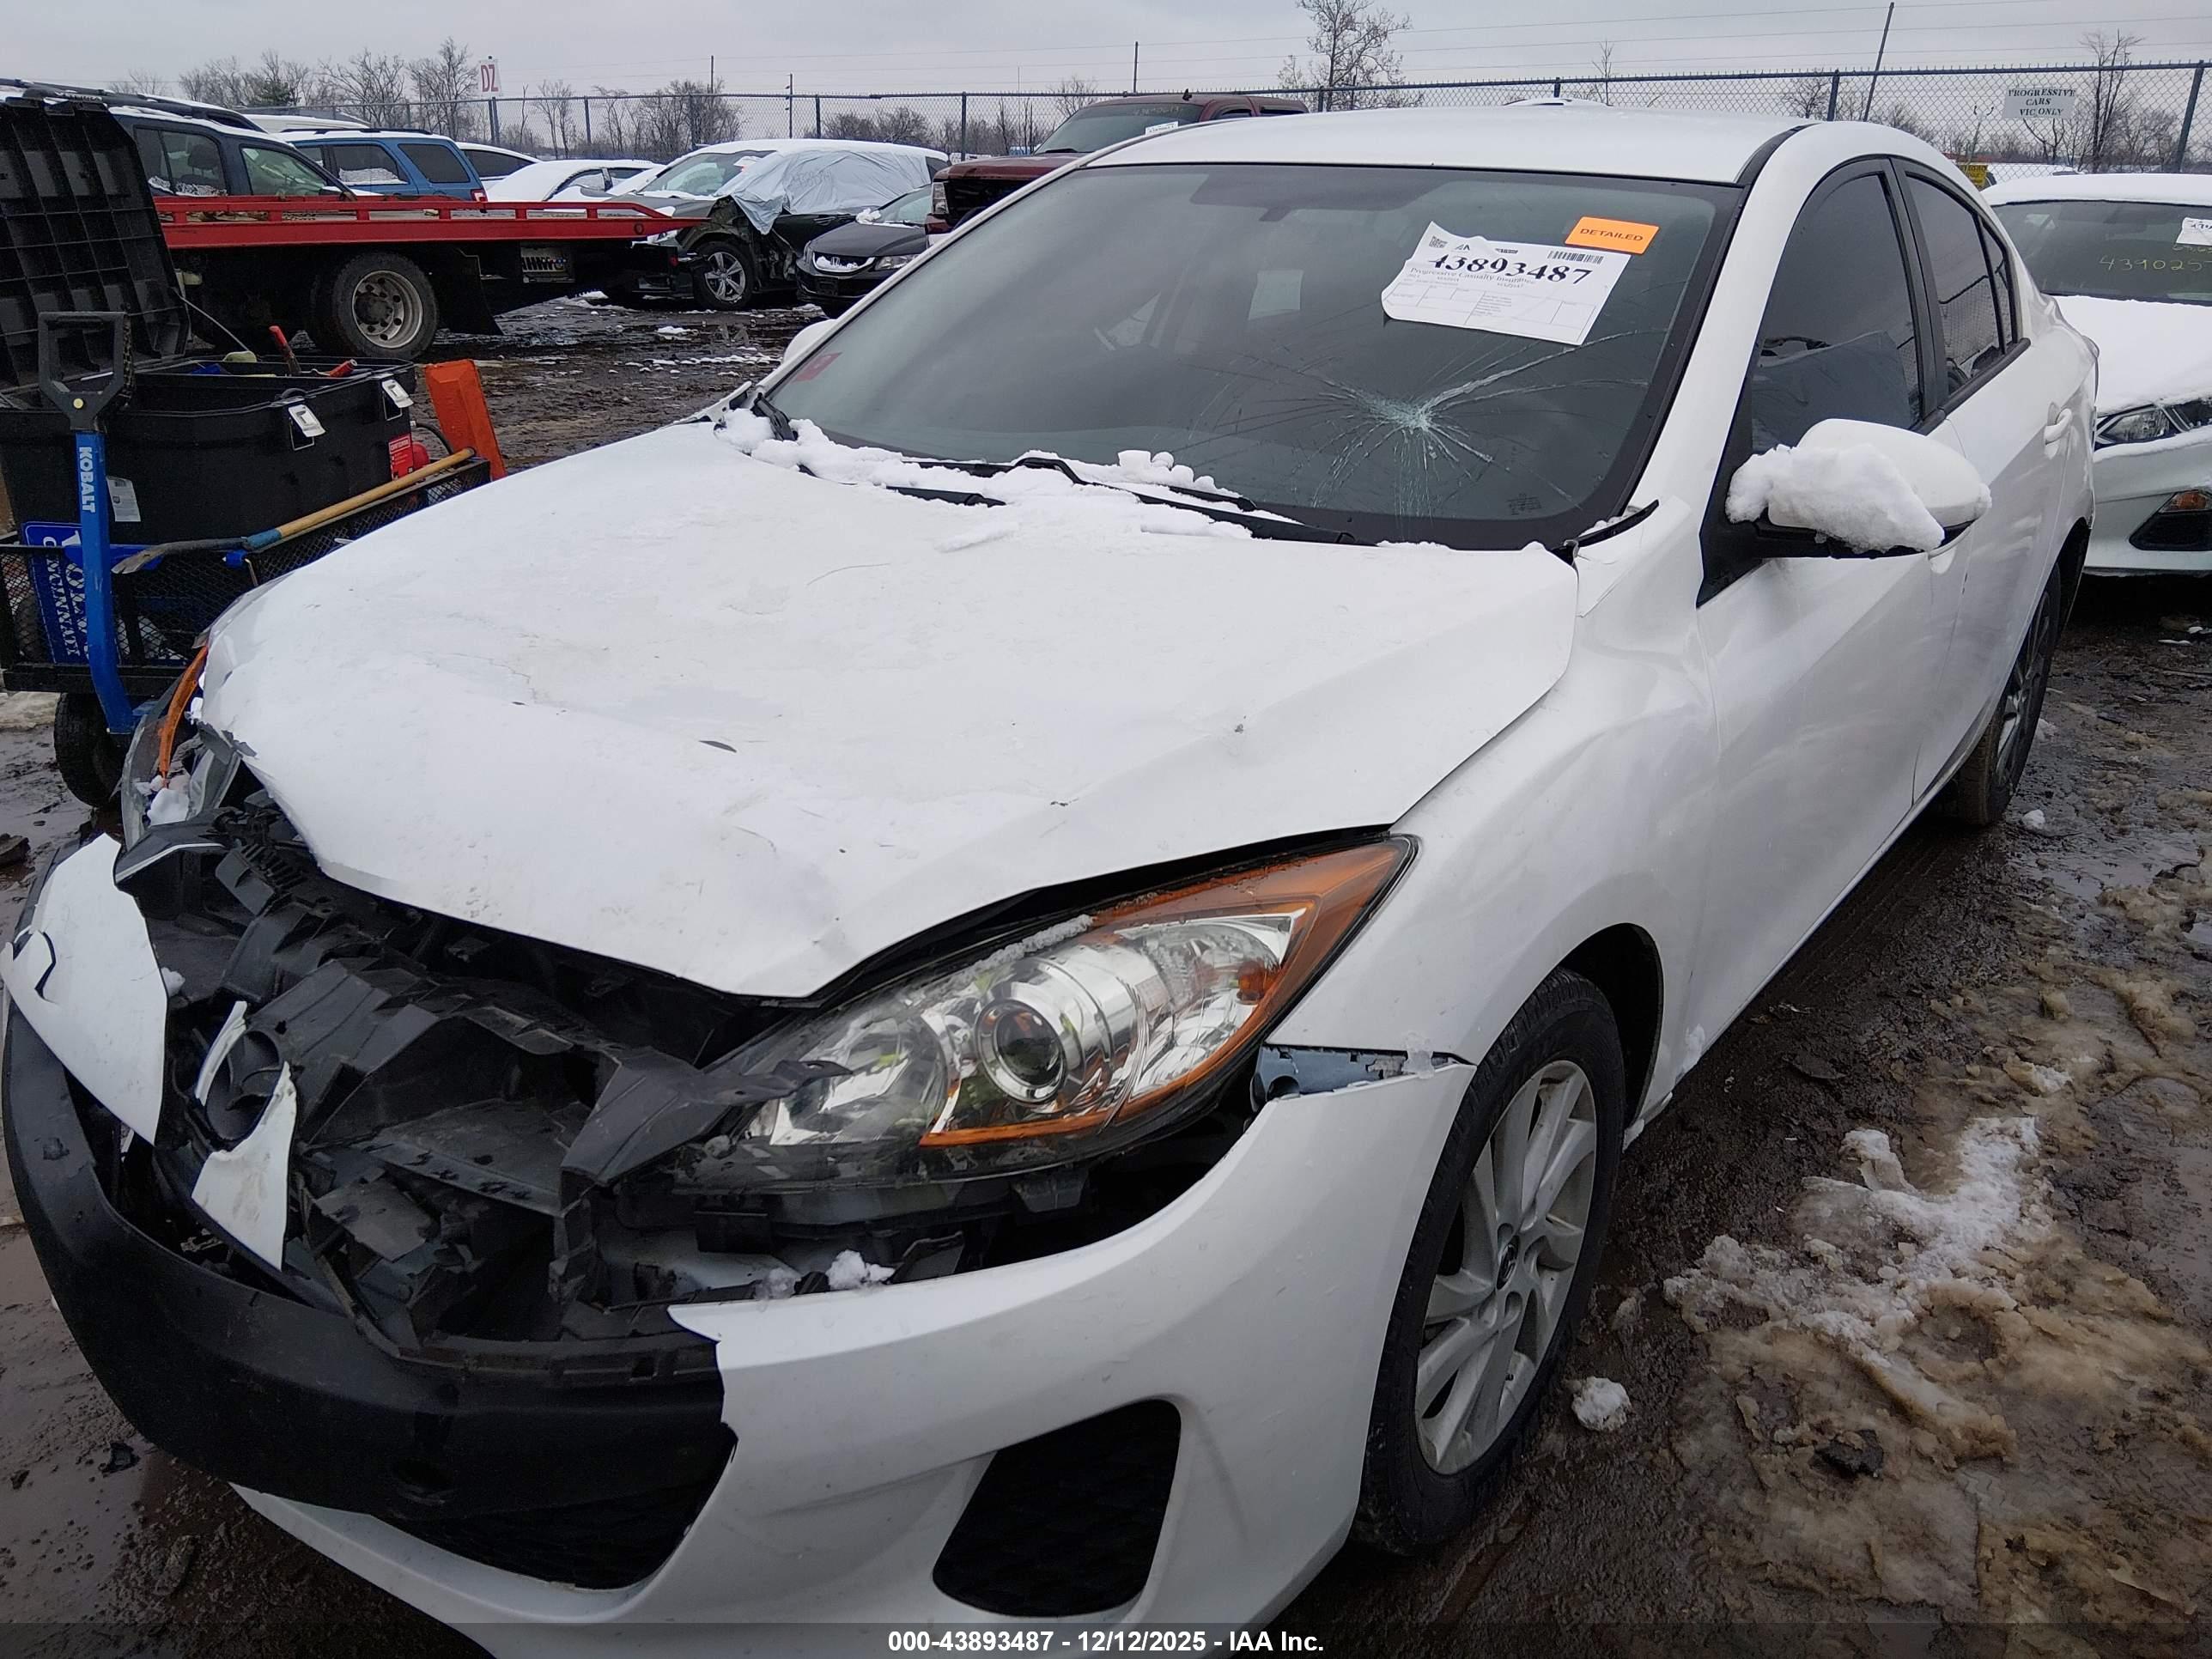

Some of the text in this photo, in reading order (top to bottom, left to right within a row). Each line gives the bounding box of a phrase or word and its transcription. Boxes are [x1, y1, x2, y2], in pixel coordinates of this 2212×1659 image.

[2008, 88, 2076, 97] PROGRESSIVE
[2026, 97, 2051, 106] CARS
[2038, 107, 2063, 116] ONLY
[1579, 228, 1644, 241] DETAILED
[1410, 267, 1457, 276] Progressive
[1459, 271, 1494, 282] Casualty
[1428, 254, 1594, 284] 43893487
[78, 447, 96, 514] KOBALT
